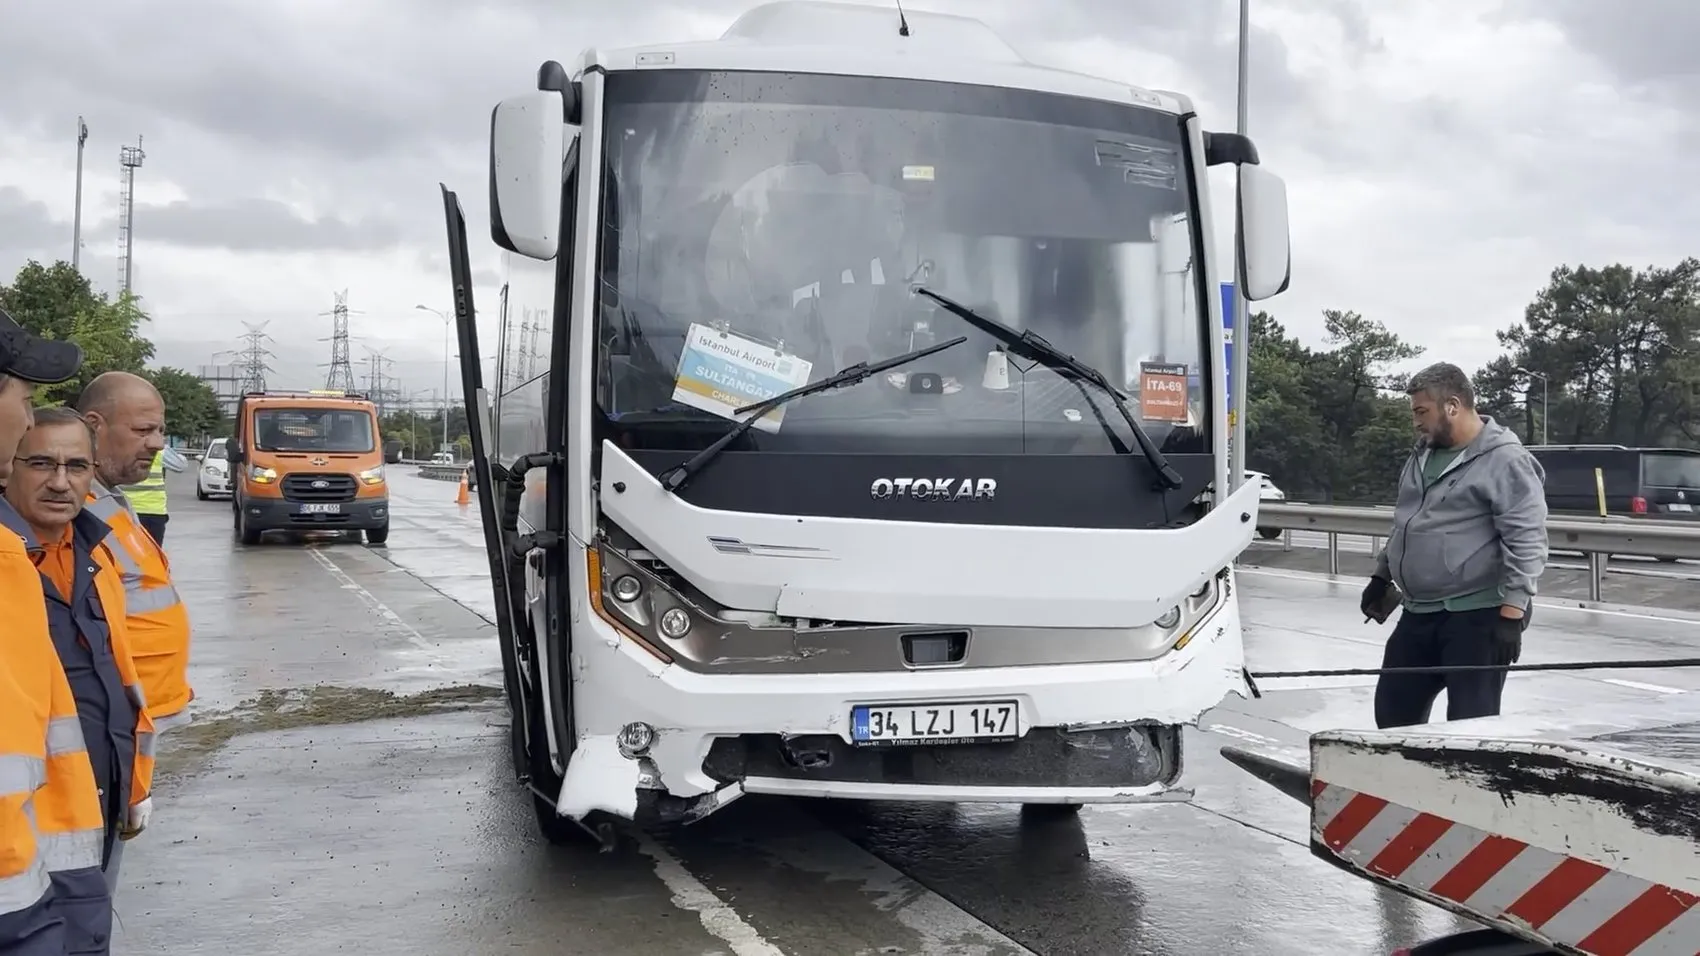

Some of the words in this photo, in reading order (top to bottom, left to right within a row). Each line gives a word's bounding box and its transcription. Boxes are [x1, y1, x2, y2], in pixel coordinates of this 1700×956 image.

[699, 336, 739, 358] Istanbul
[741, 352, 776, 370] Airport
[871, 478, 997, 501] OTOKAR
[858, 725, 869, 735] TR
[871, 711, 898, 737] 34
[911, 709, 954, 736] LZJ
[971, 708, 1010, 734] 147
